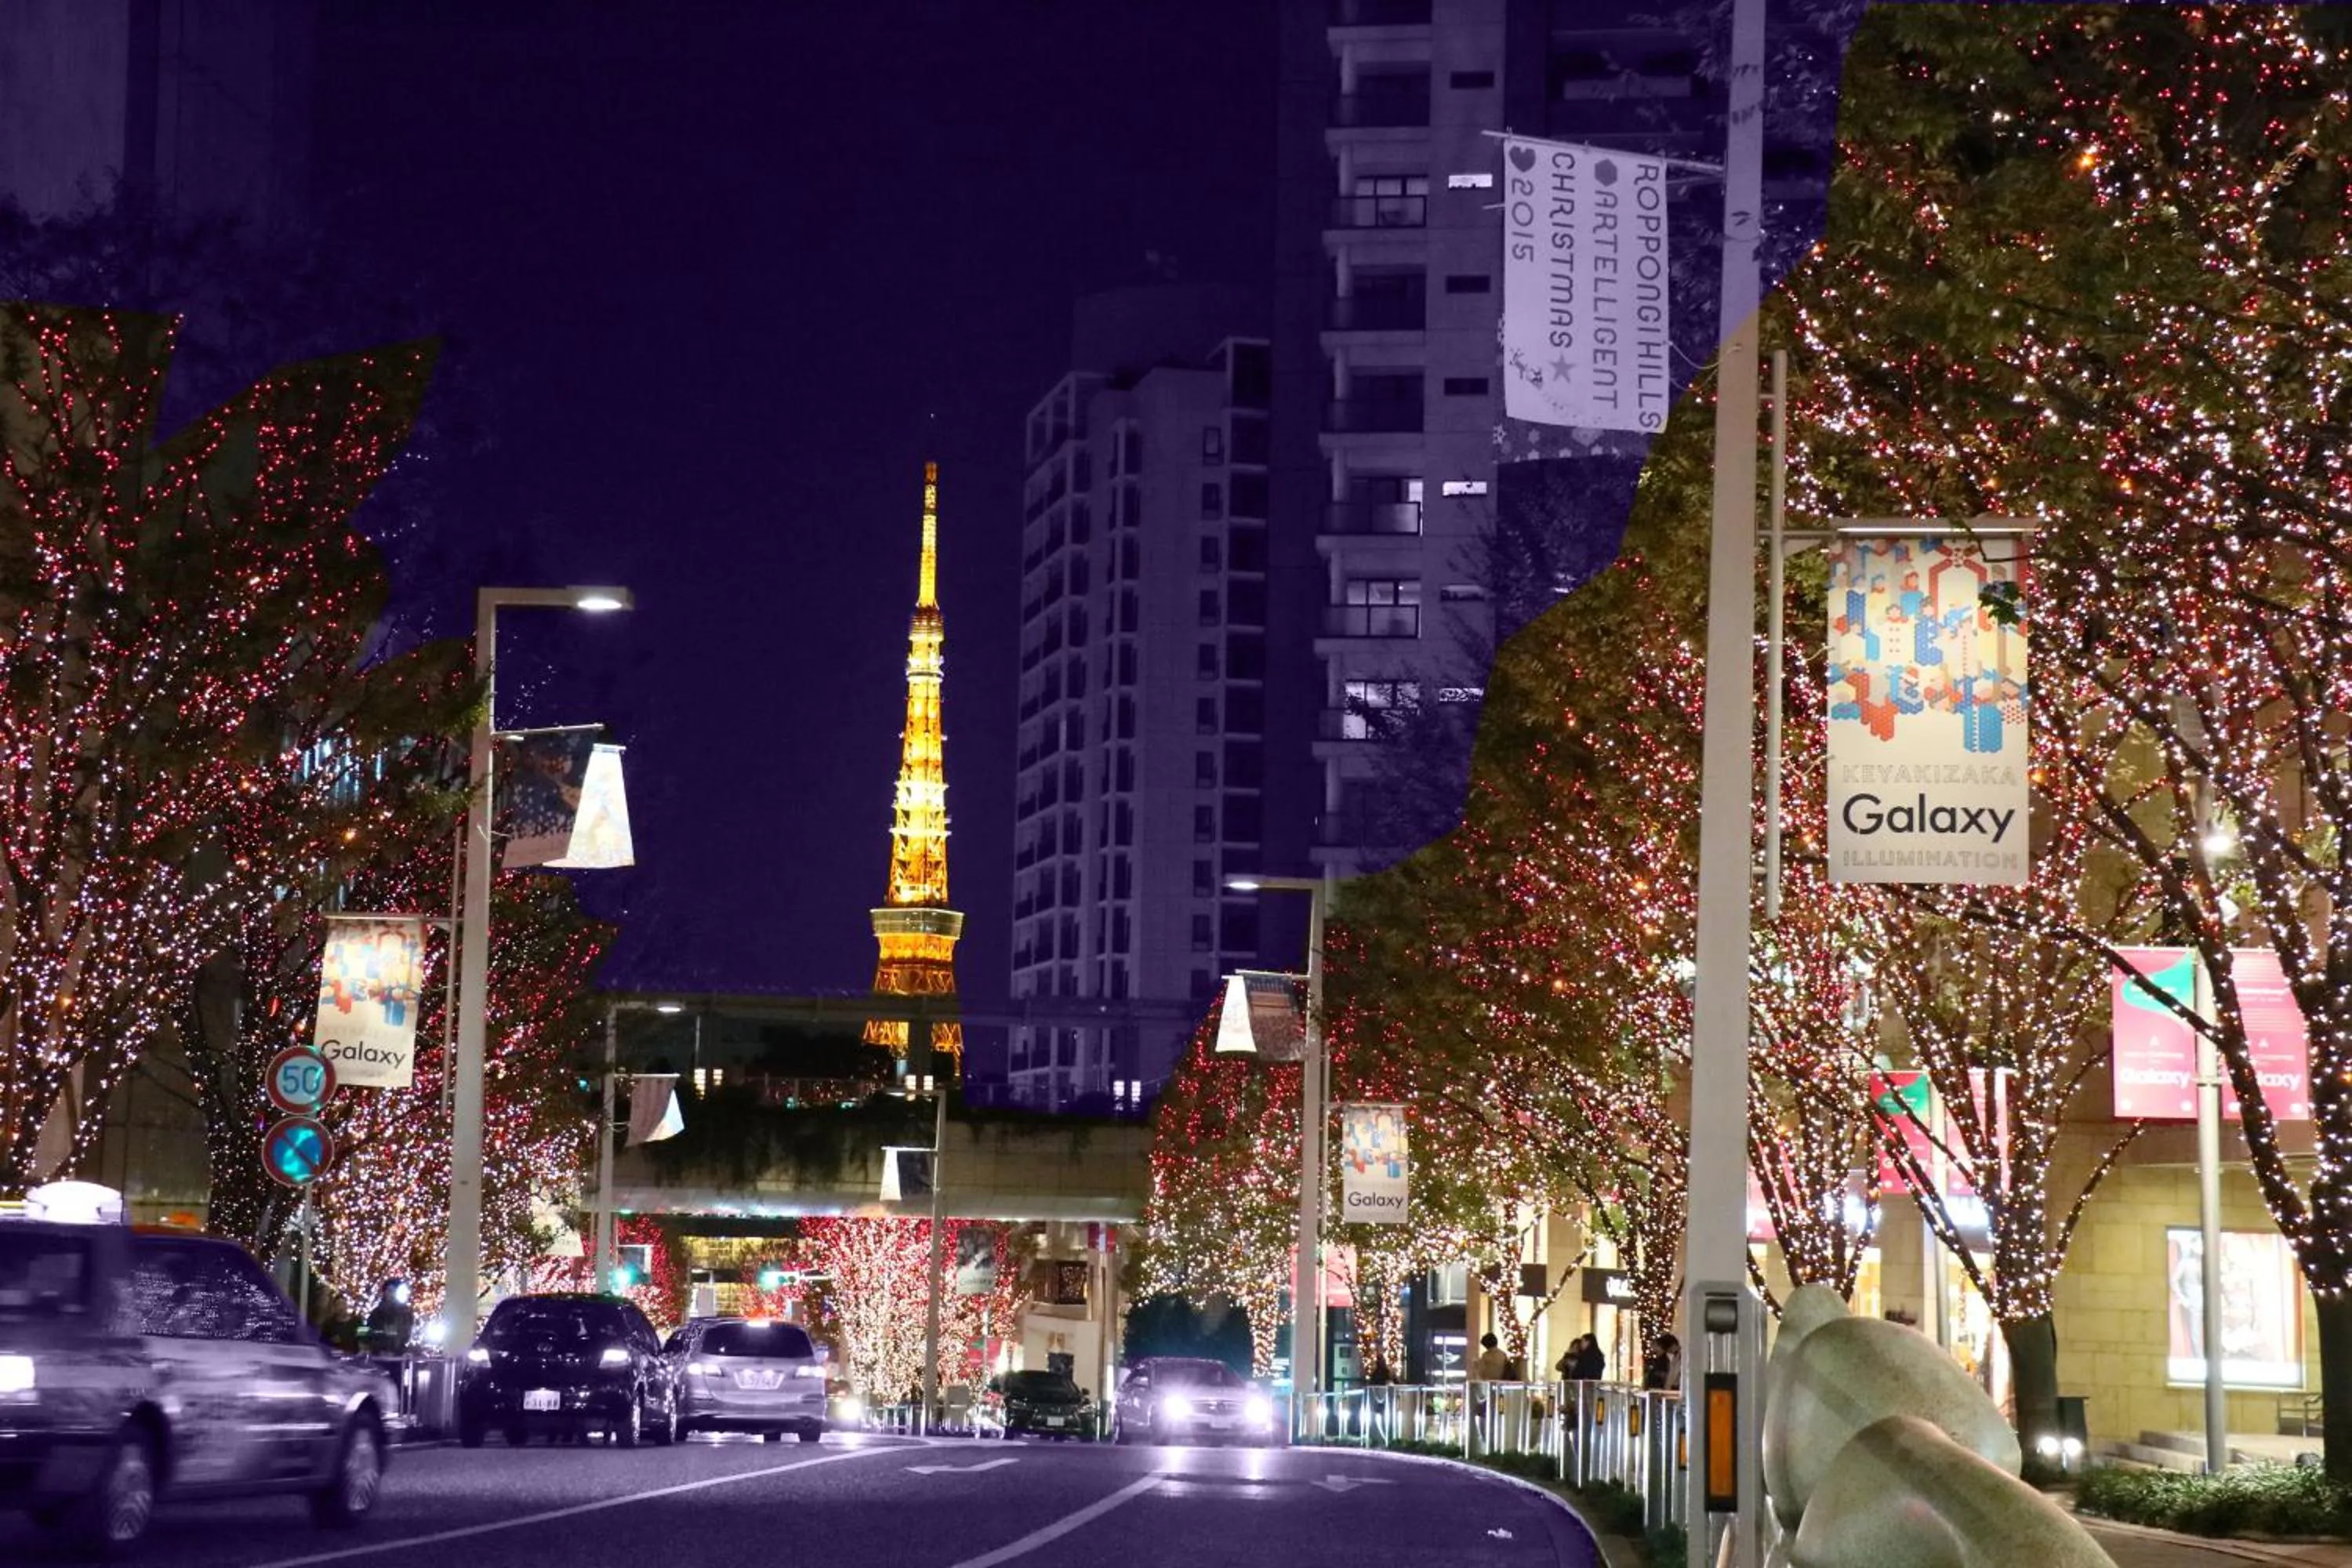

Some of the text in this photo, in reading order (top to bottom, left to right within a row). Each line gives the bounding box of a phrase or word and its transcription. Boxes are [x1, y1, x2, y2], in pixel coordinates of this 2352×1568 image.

[1511, 178, 1534, 262] 2015
[1548, 151, 1576, 348] CHRISTMAS
[1592, 190, 1619, 409] ARTELLIGENT
[1842, 764, 2018, 786] KEYAKIZAKA
[1842, 792, 2016, 844] Galaxy
[1842, 848, 2018, 869] ILLUMINATION
[320, 1039, 406, 1070] Galaxy
[283, 1065, 321, 1095] 50
[1348, 1191, 1404, 1210] Galaxy
